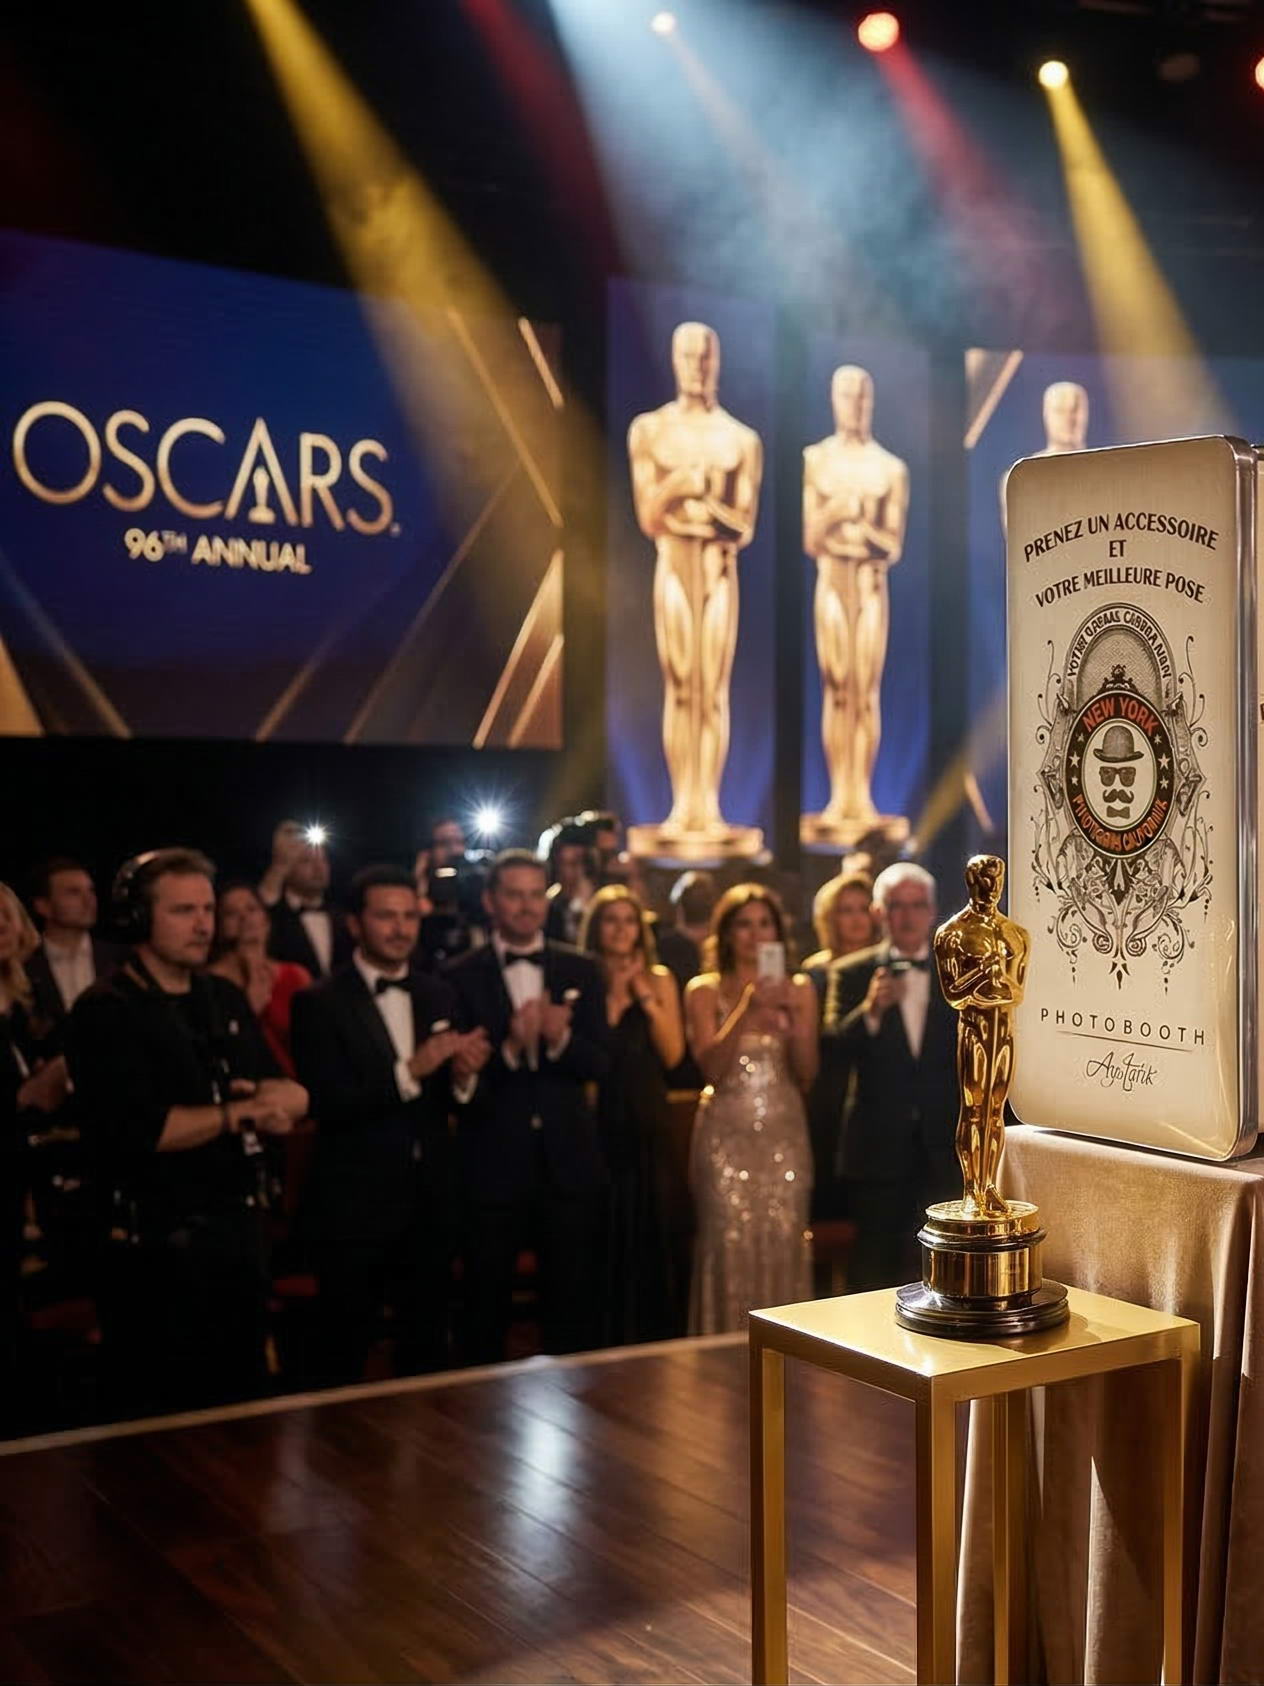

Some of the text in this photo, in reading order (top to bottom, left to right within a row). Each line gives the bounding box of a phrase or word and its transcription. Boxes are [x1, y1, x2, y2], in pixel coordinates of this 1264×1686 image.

[124, 528, 312, 574] 96TH ANNUAL
[1023, 511, 1220, 563] PRENEZ UN ACCESSOIRE
[1108, 539, 1127, 558] ET
[1035, 567, 1205, 608] VOTRE MEILLEURE POSE
[1082, 696, 1160, 737] NEW YORK
[1040, 1008, 1206, 1046] PHOTOBOOTH
